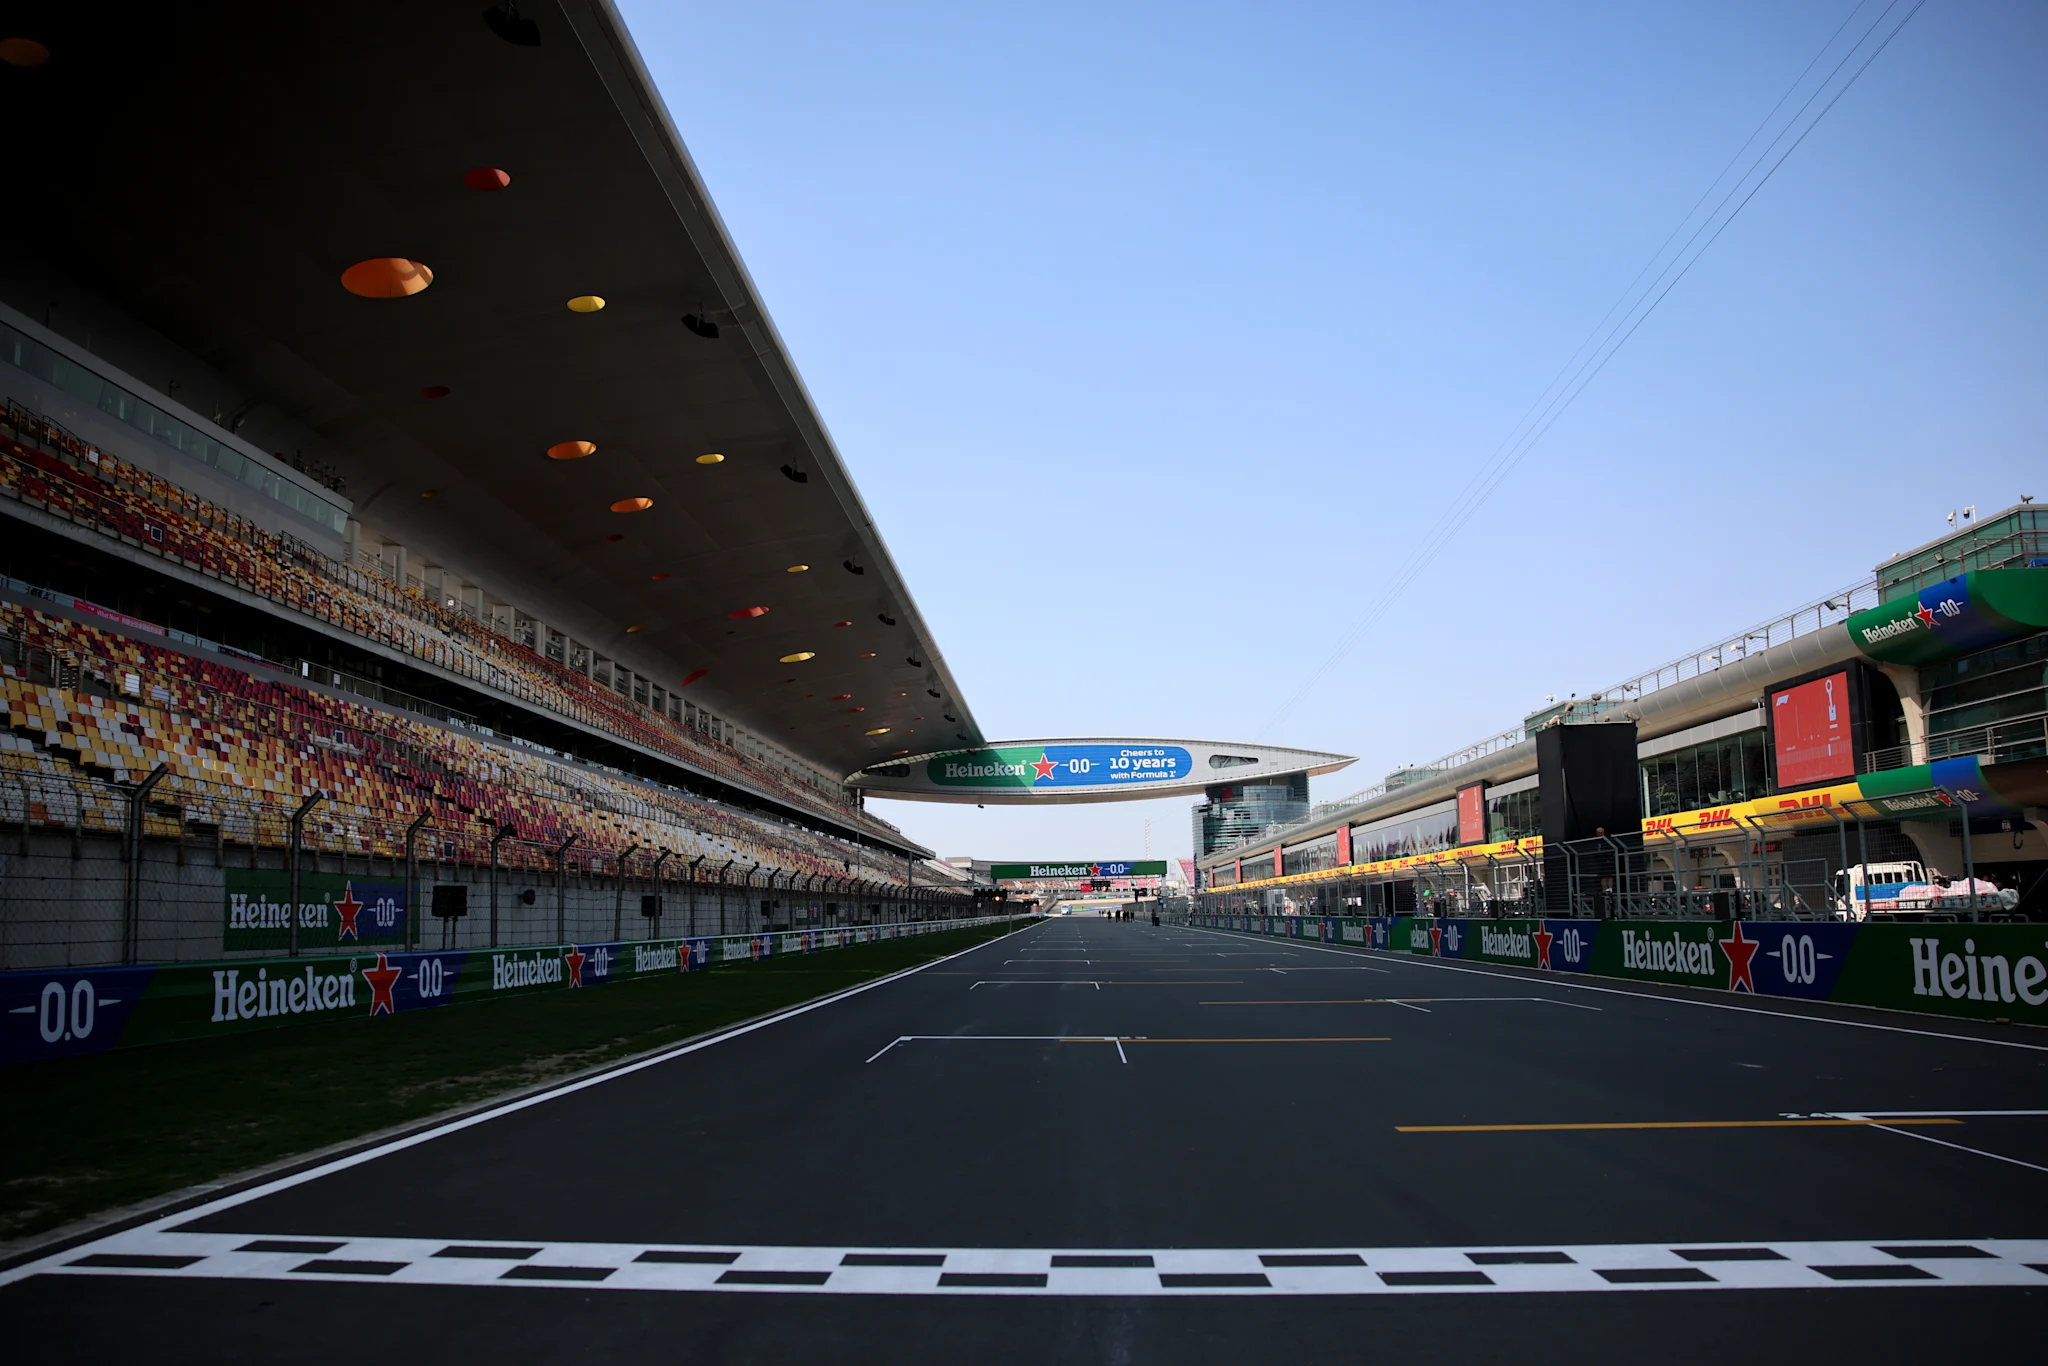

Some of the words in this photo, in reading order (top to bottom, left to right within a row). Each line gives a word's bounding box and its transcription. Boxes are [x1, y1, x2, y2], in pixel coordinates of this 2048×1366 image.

[1862, 616, 1919, 644] Heineken
[1109, 757, 1130, 769] 10
[1132, 757, 1176, 771] years
[1120, 749, 1153, 757] Cheers
[1154, 748, 1165, 757] to
[945, 762, 1026, 778] Heineken
[1110, 771, 1130, 780] with
[1131, 771, 1168, 780] Formula
[1882, 796, 1939, 811] Heineken
[1645, 818, 1674, 836] DHL
[1698, 808, 1732, 829] DHL
[1030, 865, 1087, 876] Heineken
[1480, 926, 1531, 959] Heineken
[635, 944, 677, 973] Heineken
[1621, 929, 1716, 976] Heineken
[1781, 933, 1816, 985] 0.0
[492, 951, 563, 991] Heineken
[1909, 937, 2048, 1006] Heine
[211, 965, 356, 1023] Heineken
[40, 979, 95, 1043] 0.0
